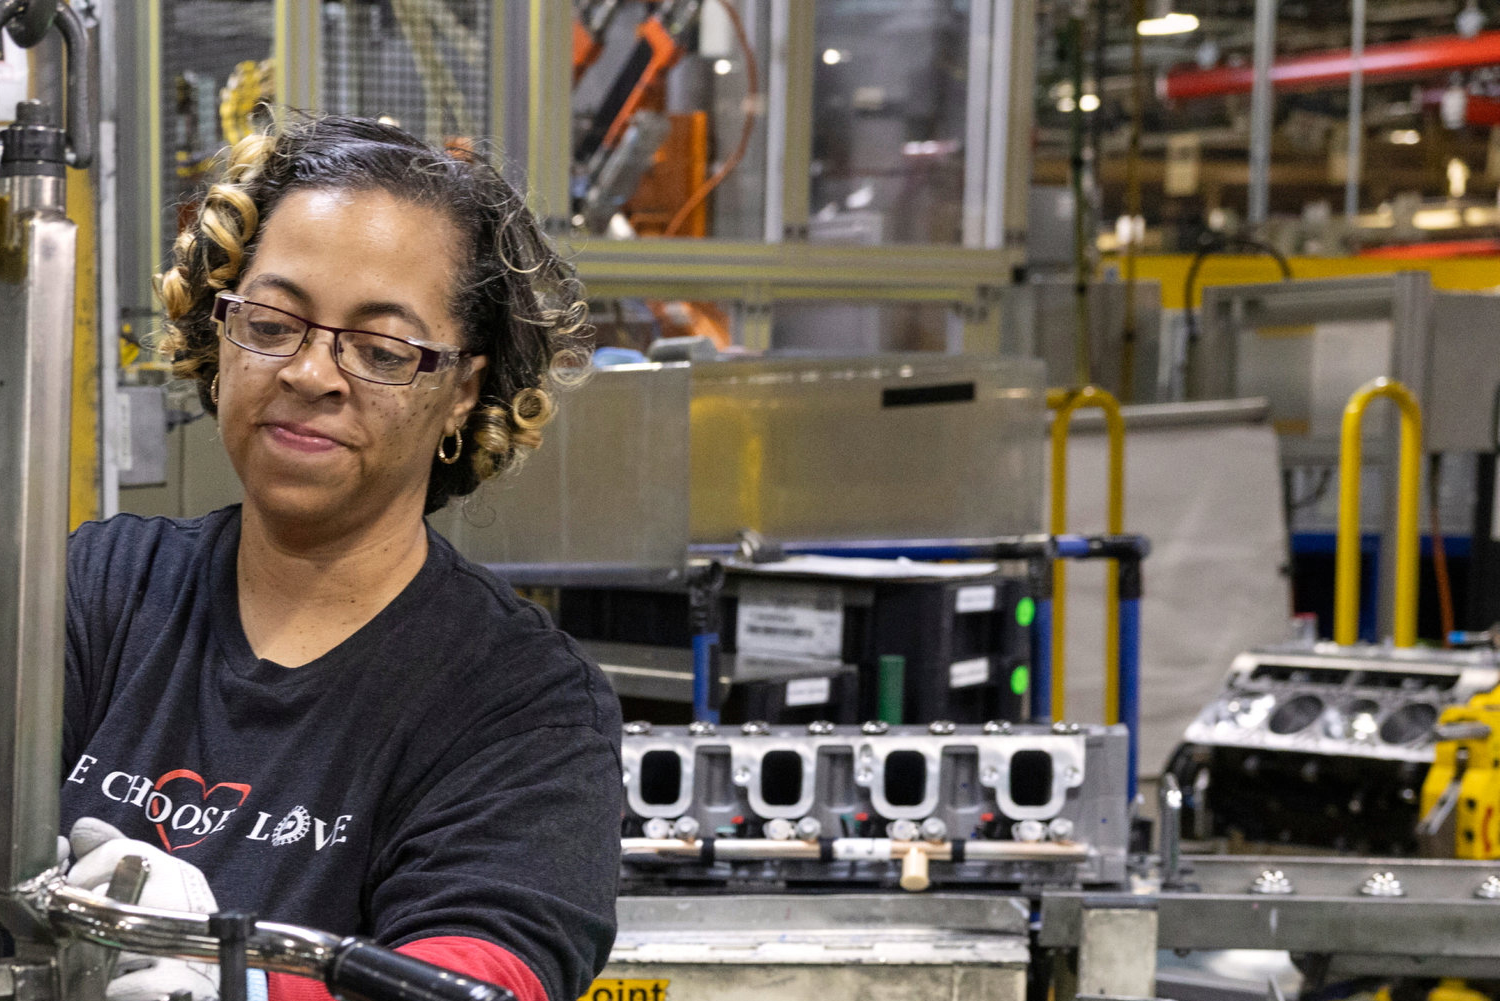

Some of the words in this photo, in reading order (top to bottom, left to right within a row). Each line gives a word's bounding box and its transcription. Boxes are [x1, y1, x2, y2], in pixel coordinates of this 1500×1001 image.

[67, 754, 98, 784] E
[101, 771, 238, 835] CHOOSE
[246, 805, 353, 851] LOVE
